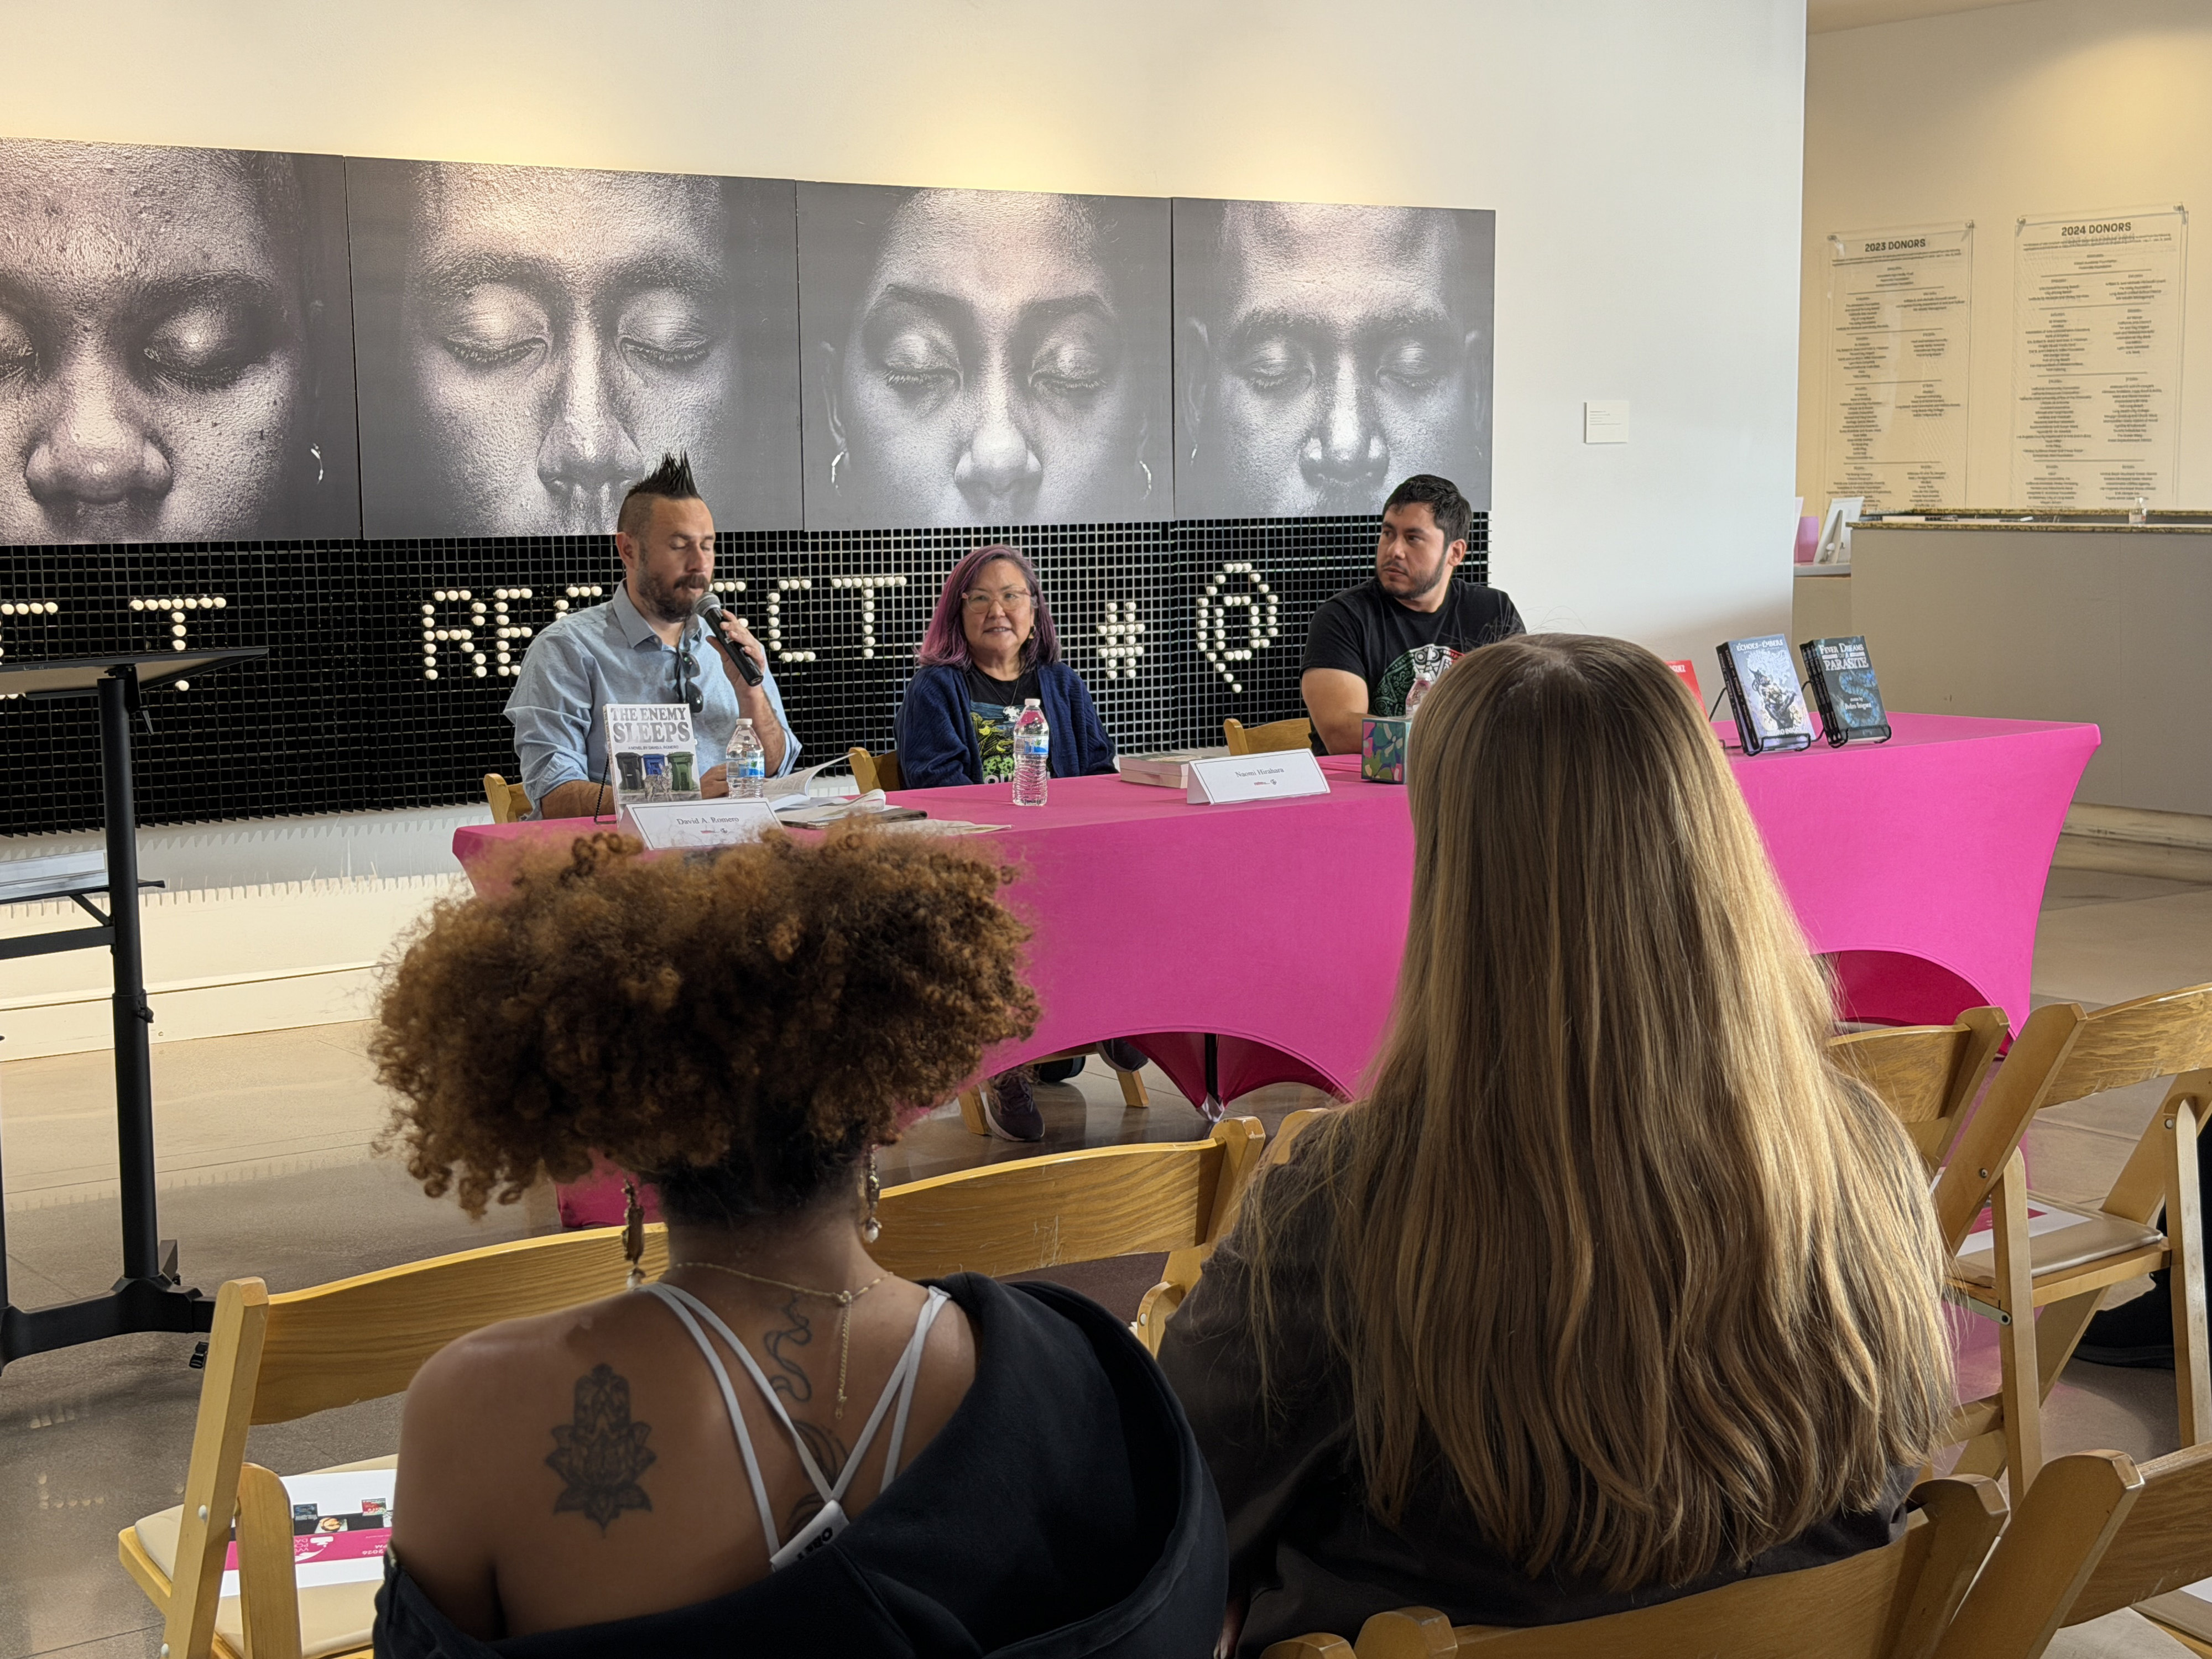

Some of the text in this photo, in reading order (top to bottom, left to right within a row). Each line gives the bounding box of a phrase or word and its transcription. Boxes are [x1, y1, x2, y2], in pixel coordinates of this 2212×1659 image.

[2061, 222, 2132, 236] 2024 DONORS
[1865, 238, 1926, 252] 2023 DONORS
[422, 576, 908, 681] RECT
[1823, 657, 1869, 671] PARASITE
[611, 707, 686, 721] THE ENEMY
[613, 721, 690, 743] SLEEPS
[1235, 769, 1257, 778] Naomi
